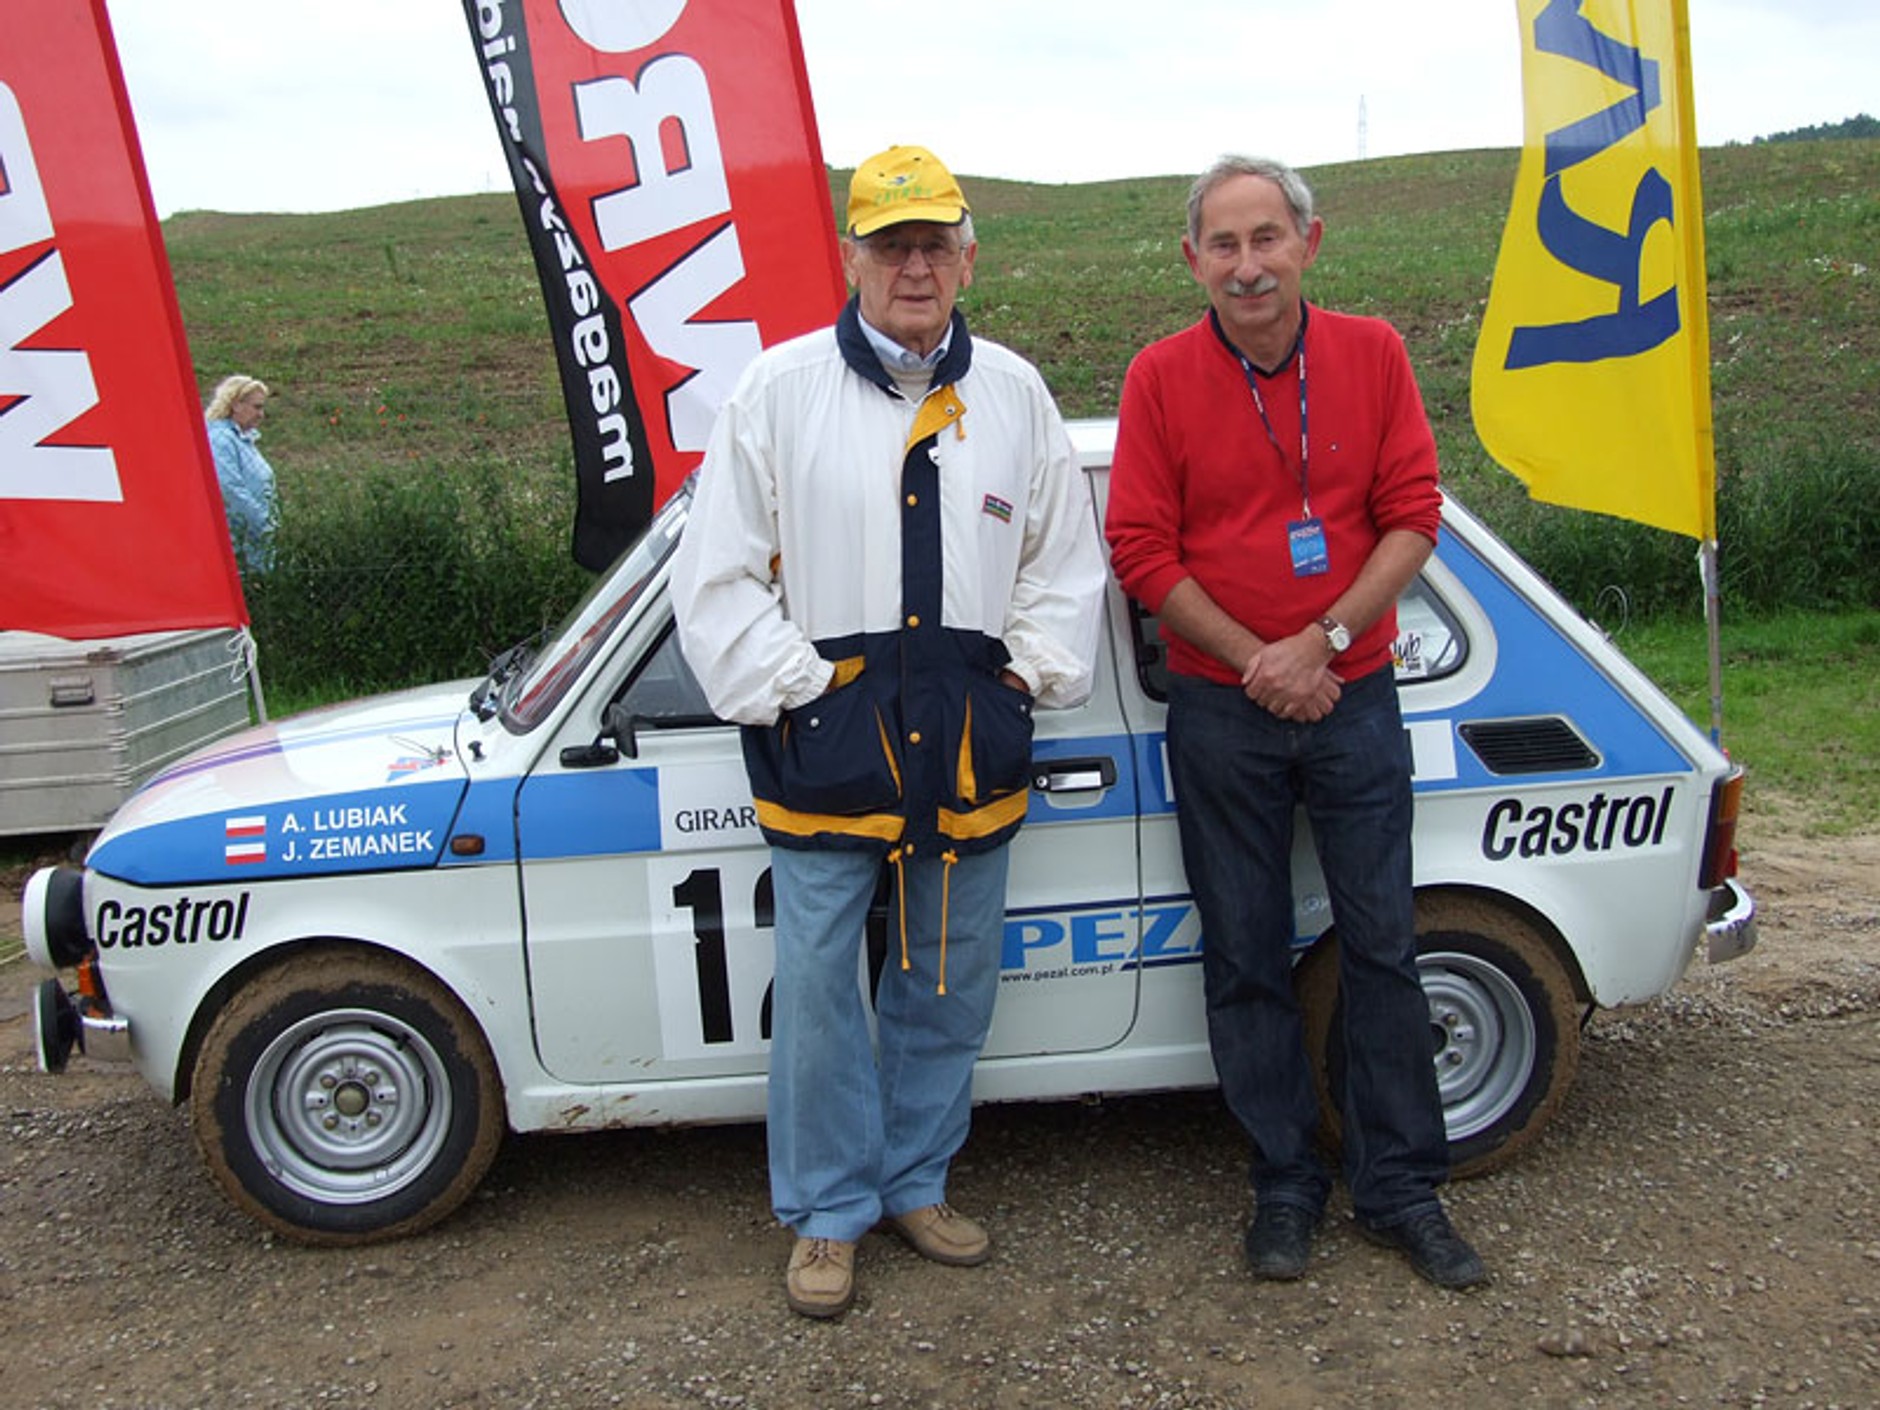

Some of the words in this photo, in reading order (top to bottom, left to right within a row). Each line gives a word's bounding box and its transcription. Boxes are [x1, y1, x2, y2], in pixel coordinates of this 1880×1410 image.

[281, 813, 307, 834] A.
[313, 804, 408, 831] LUBIAK
[1482, 786, 1675, 862] Castrol
[281, 844, 303, 863] J.
[310, 830, 434, 861] ZEMANEK
[96, 892, 250, 949] Castrol
[1000, 905, 1204, 970] PEZ
[1001, 962, 1114, 984] www.pezal.com.pl
